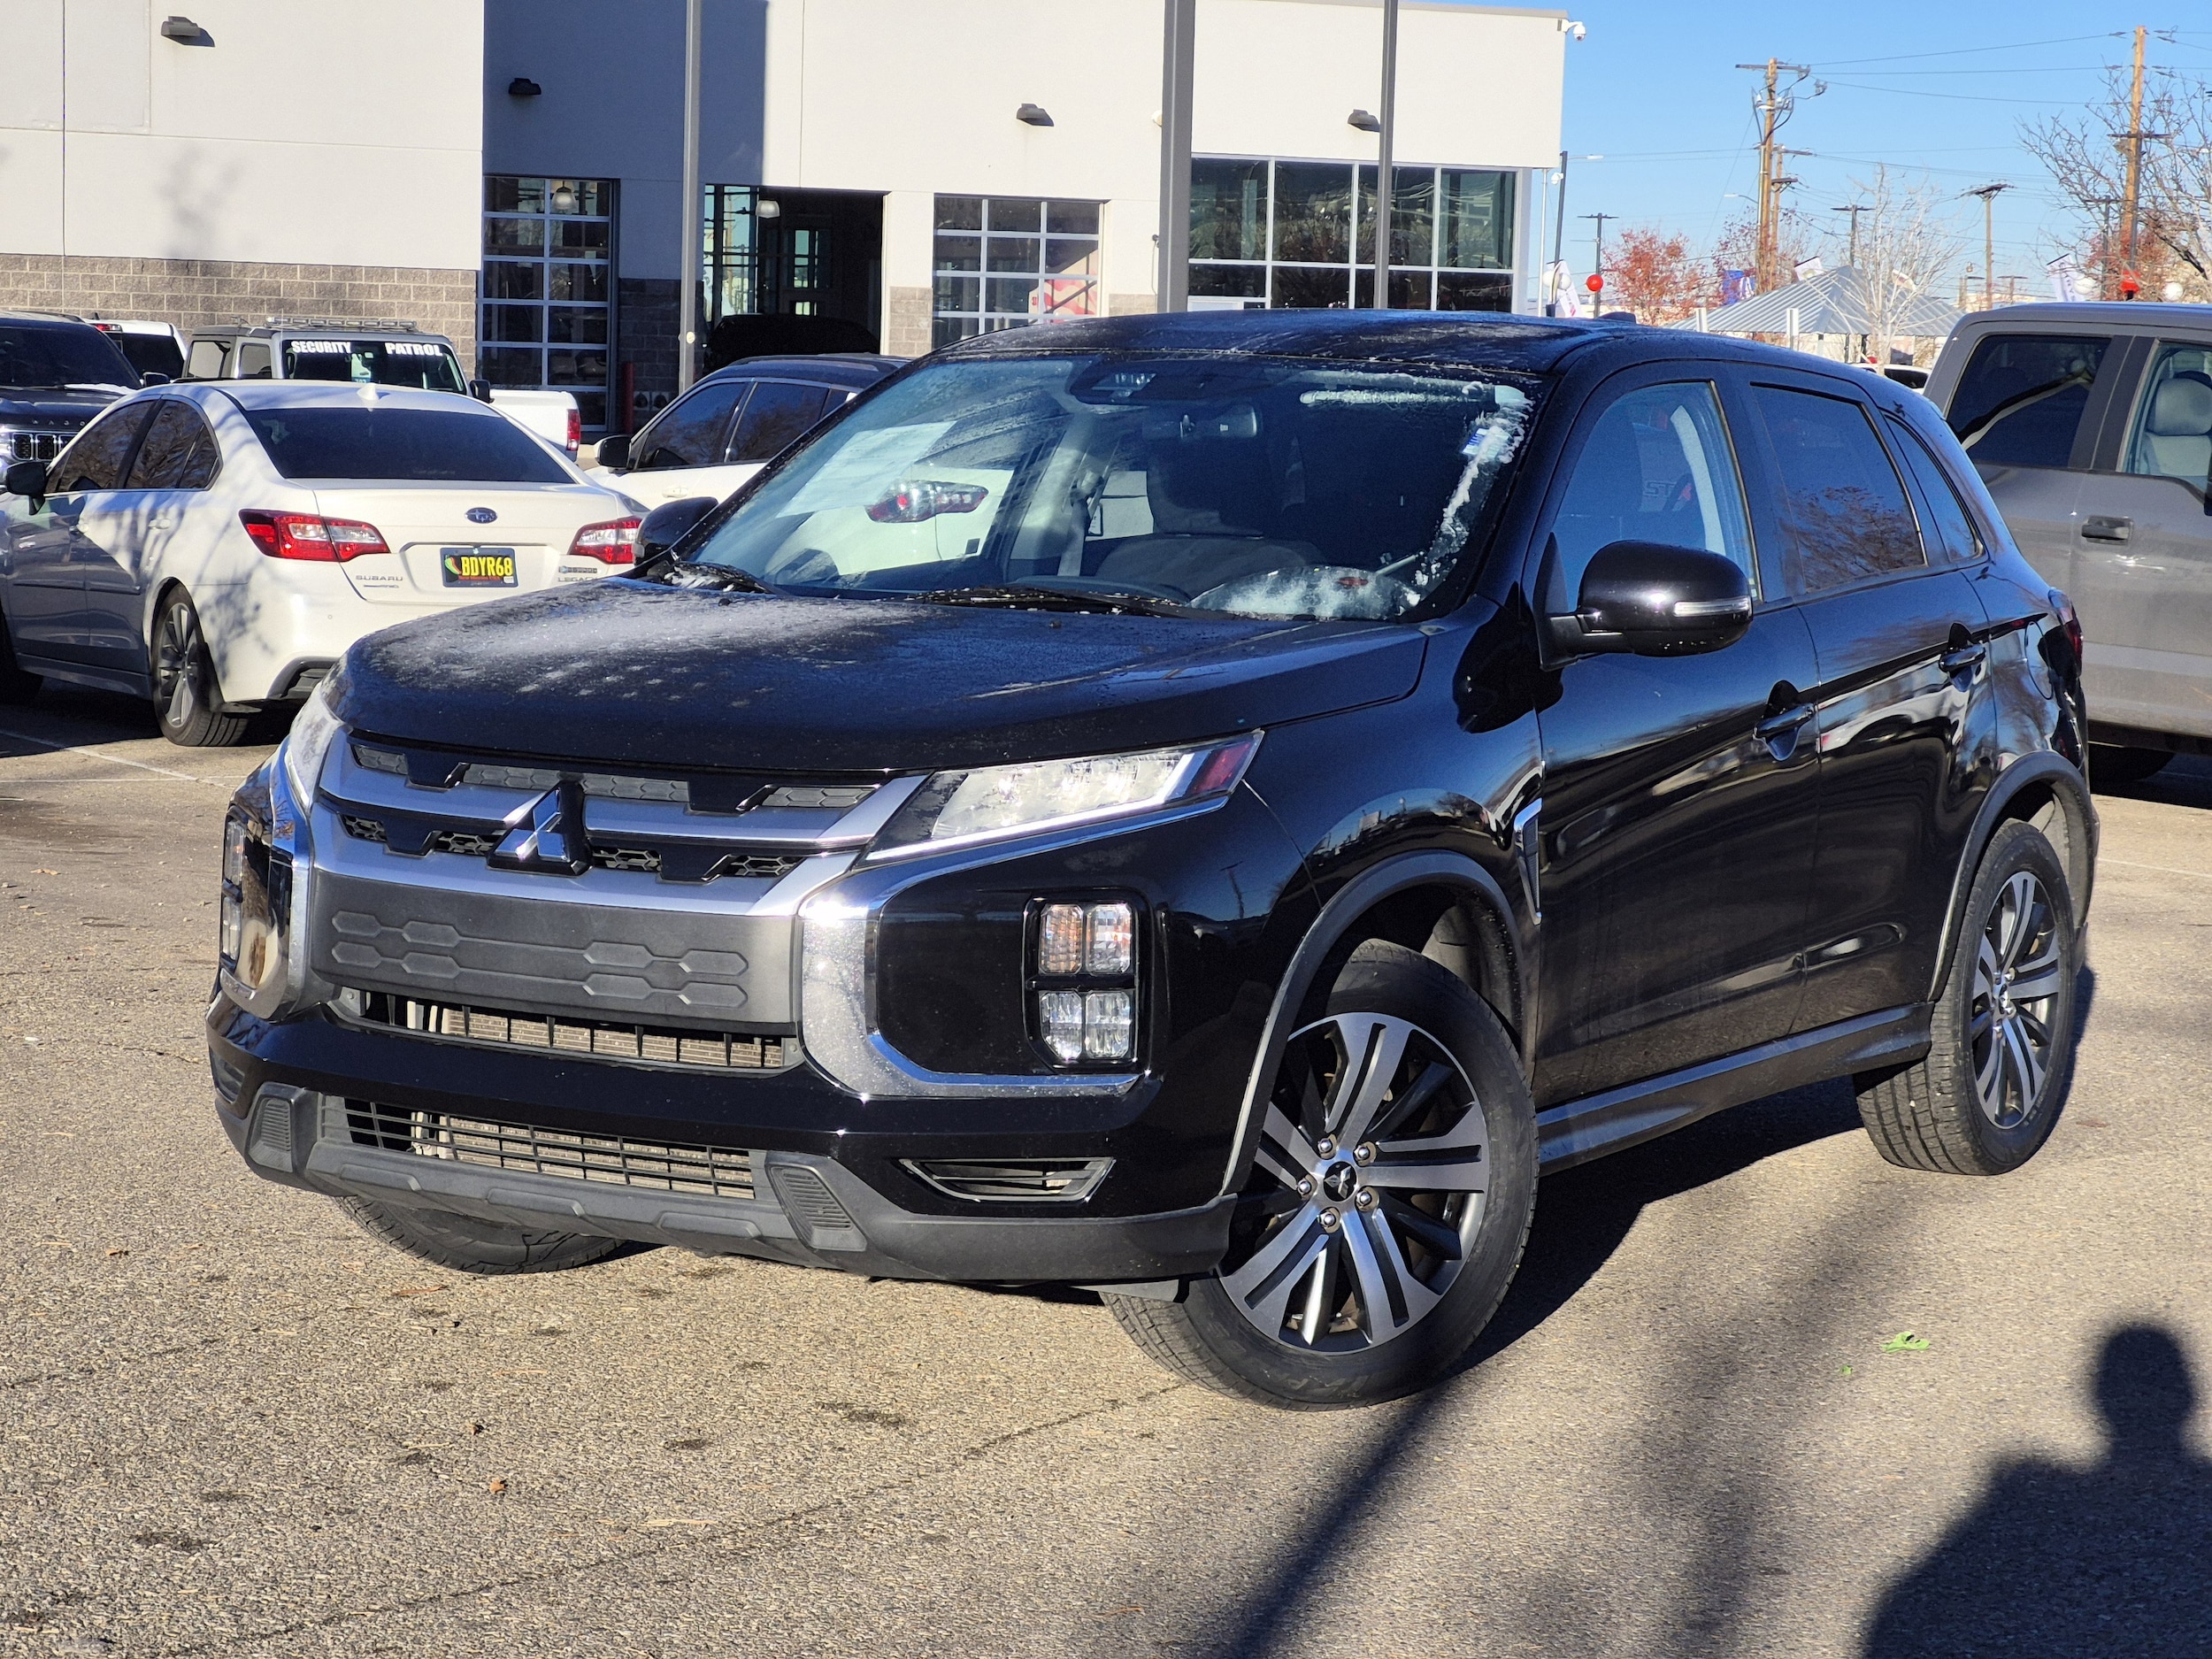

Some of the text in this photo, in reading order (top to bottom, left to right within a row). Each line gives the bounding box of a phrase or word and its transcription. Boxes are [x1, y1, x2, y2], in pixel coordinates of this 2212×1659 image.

[291, 341, 442, 356] SECURITY PATROL
[461, 557, 513, 576] BDYR68
